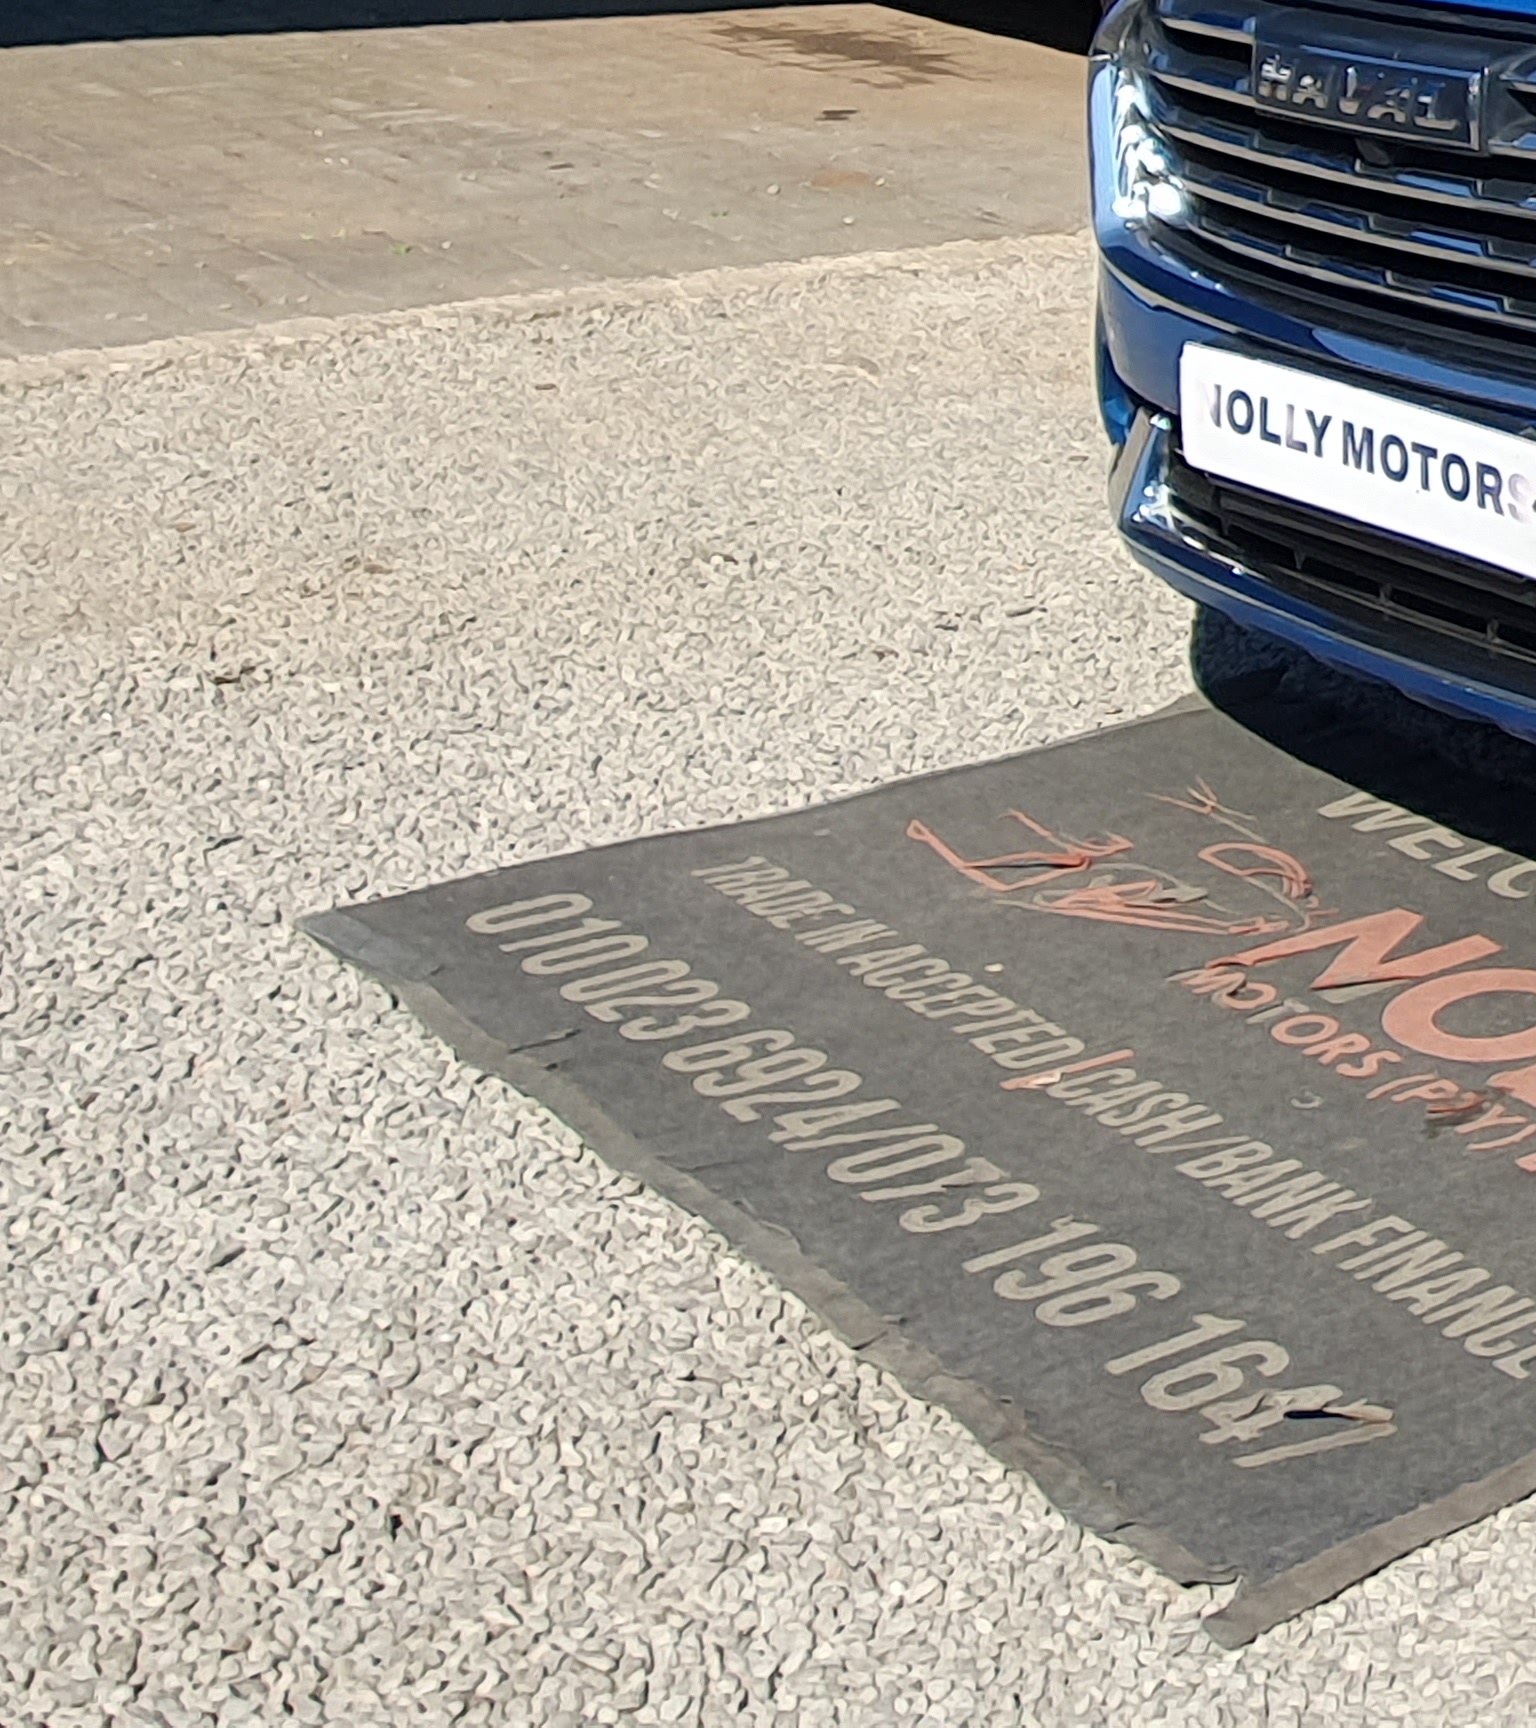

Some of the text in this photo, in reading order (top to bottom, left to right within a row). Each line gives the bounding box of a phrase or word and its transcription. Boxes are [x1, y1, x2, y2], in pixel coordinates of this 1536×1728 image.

[1342, 420, 1533, 524] MOTORS
[690, 855, 856, 929] TRADE
[795, 918, 899, 953] IN
[1168, 966, 1402, 1078] MOTORS
[466, 893, 649, 975] 010
[559, 959, 751, 1040] 023
[962, 1214, 1182, 1327] 196
